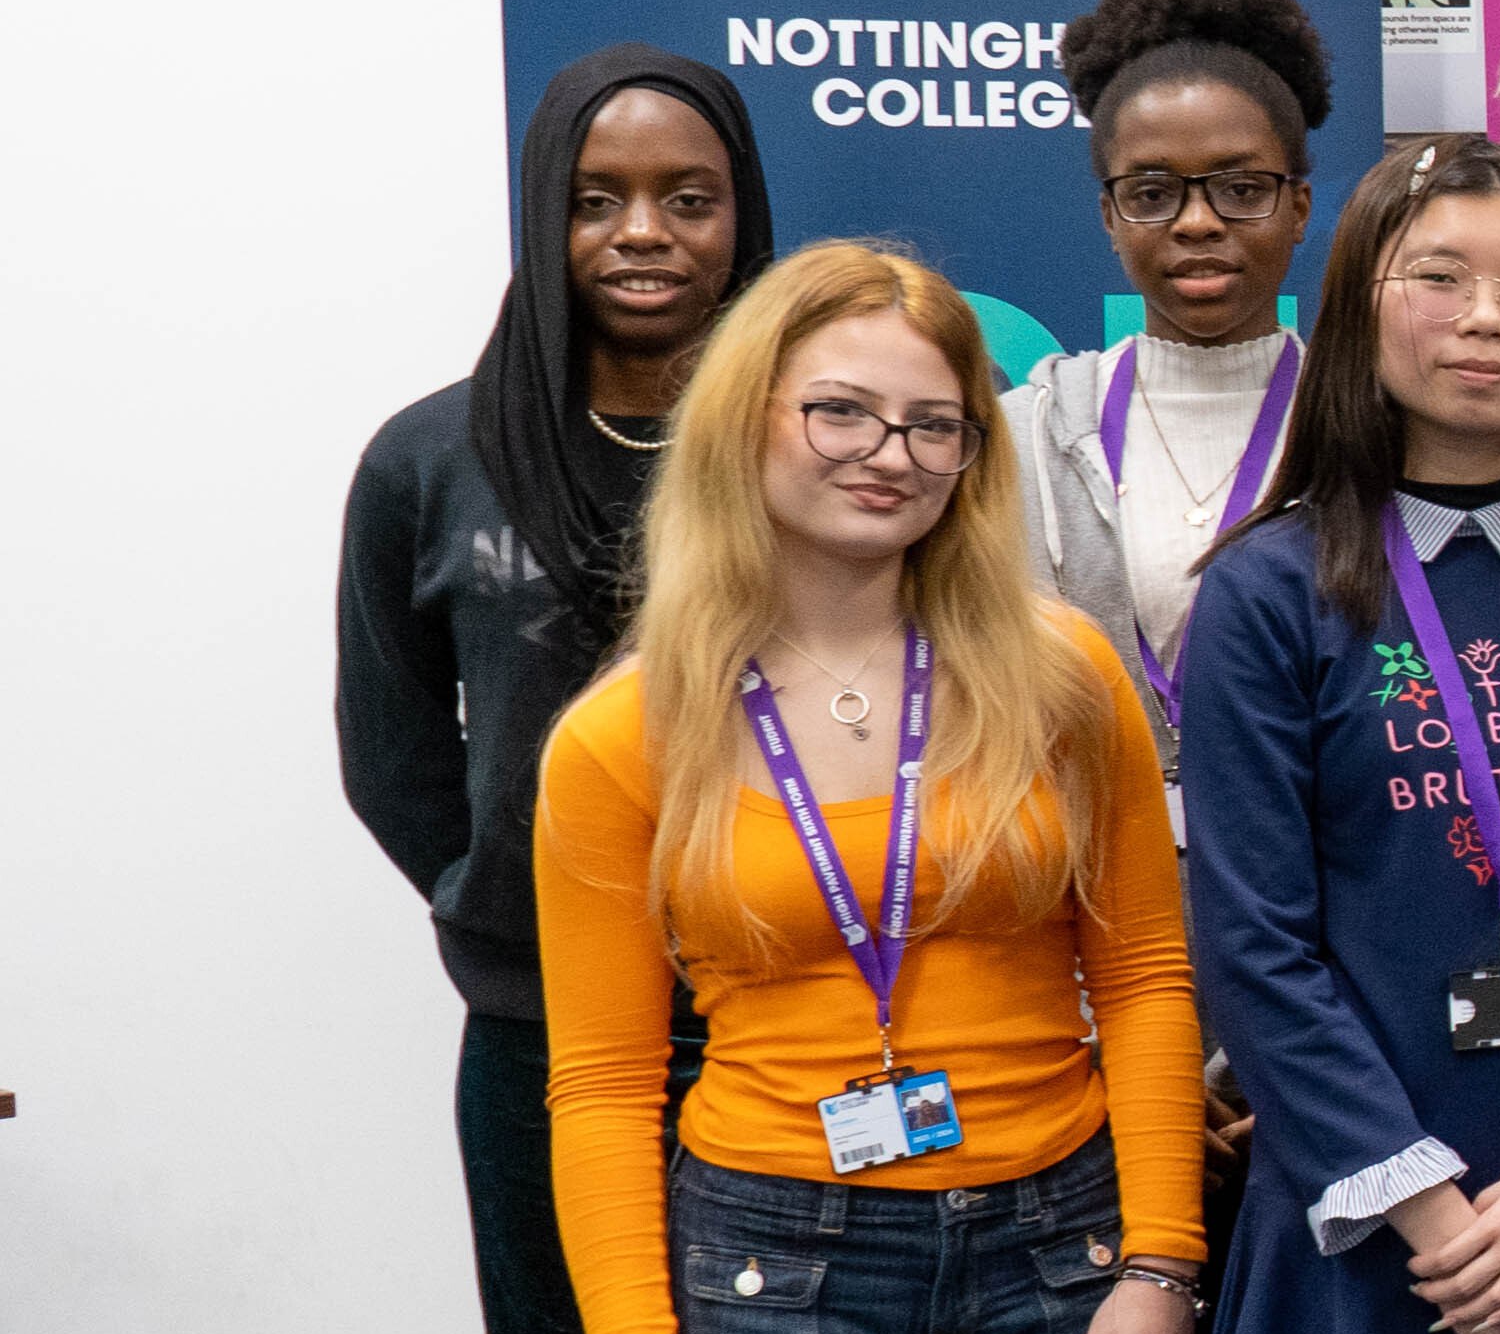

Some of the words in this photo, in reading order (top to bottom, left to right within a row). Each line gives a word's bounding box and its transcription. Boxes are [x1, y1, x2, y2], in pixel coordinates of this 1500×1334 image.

[1398, 25, 1440, 34] otherwise
[1440, 25, 1470, 34] hidden
[1410, 14, 1431, 22] from
[1432, 15, 1456, 24] space
[728, 17, 1066, 69] NOTTINGH
[1388, 37, 1439, 47] phenomena
[909, 693, 924, 737] STUDENT
[758, 713, 786, 756] STUDENT
[783, 777, 803, 807] FORM
[795, 807, 819, 839] SIXTH
[897, 804, 916, 865] PAVEMENT
[808, 836, 841, 894] PAVEMENT
[893, 867, 910, 903] SIXTH
[832, 893, 854, 925] HIGH
[888, 902, 906, 939] FORM
